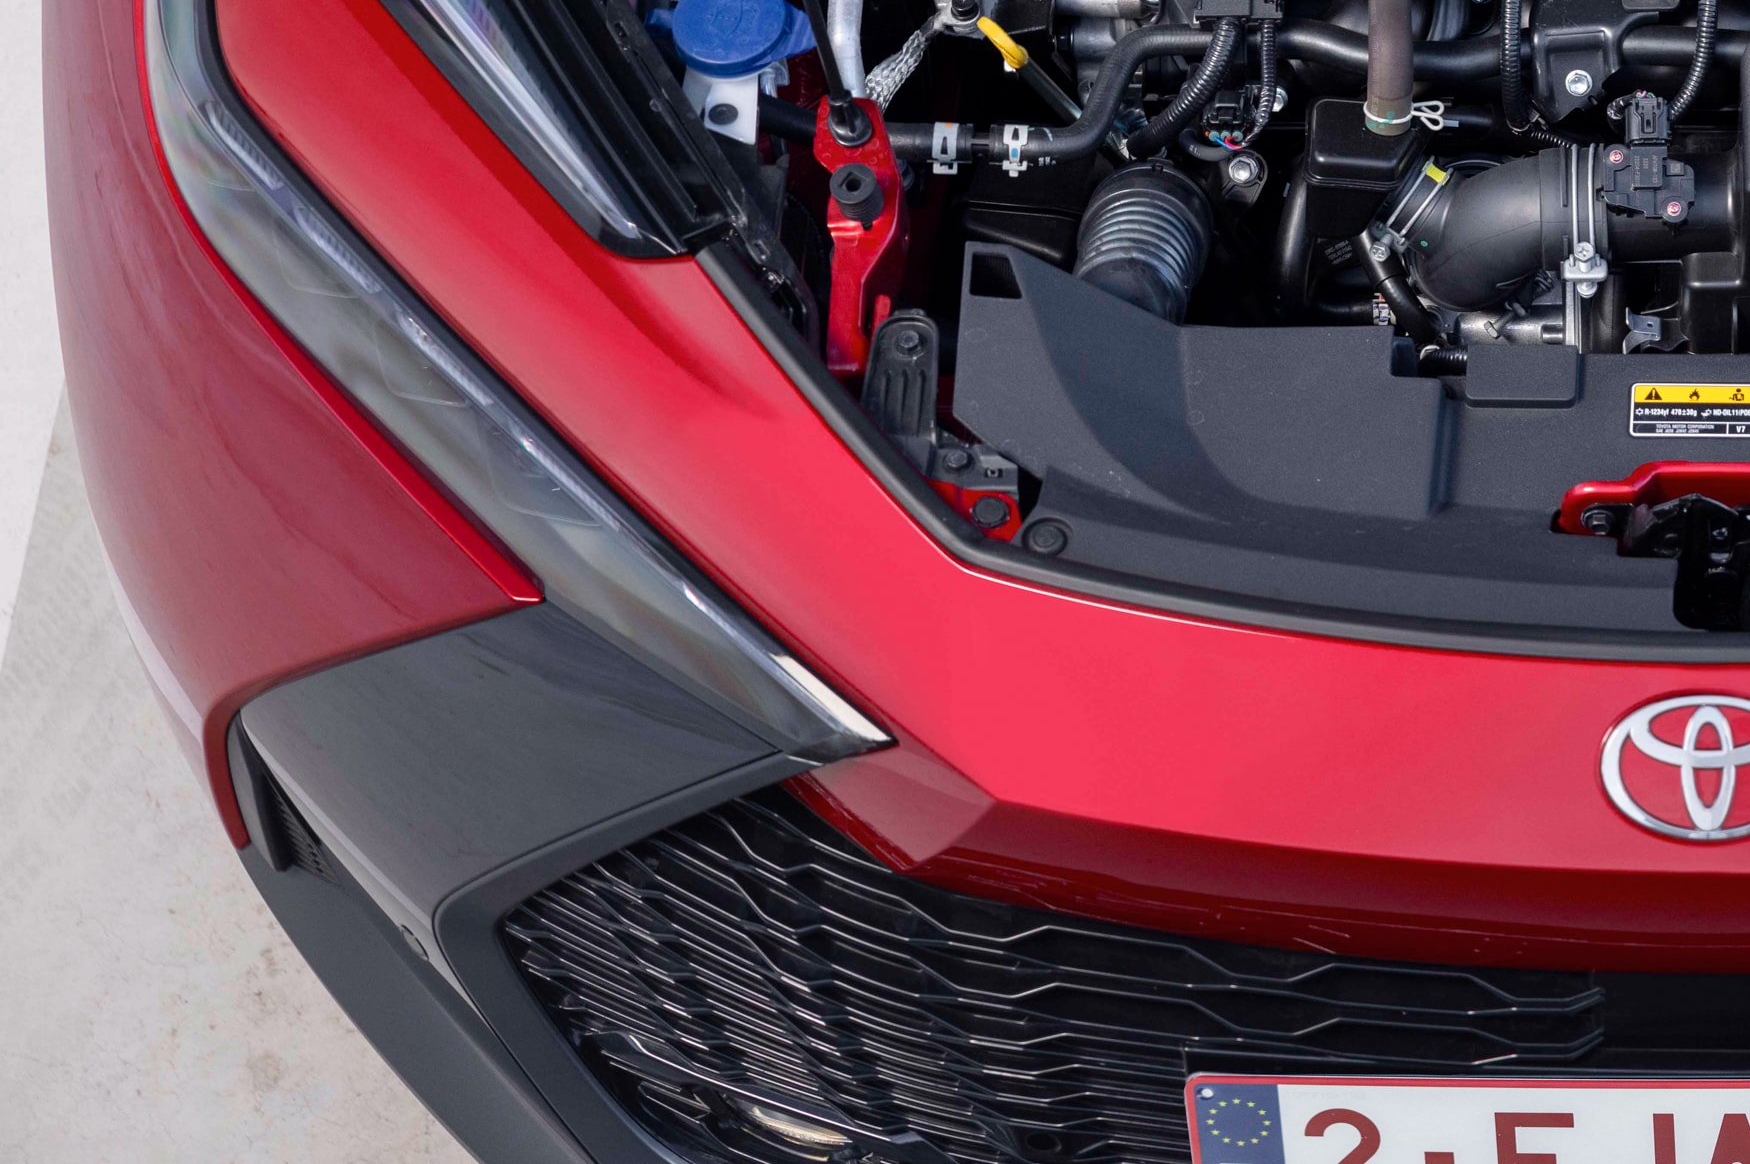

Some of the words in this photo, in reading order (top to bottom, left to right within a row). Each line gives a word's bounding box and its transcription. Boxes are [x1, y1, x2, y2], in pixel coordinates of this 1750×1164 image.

[1644, 408, 1669, 417] R-1234yf
[1671, 408, 1698, 417] 470±30g
[1735, 425, 1747, 433] V7
